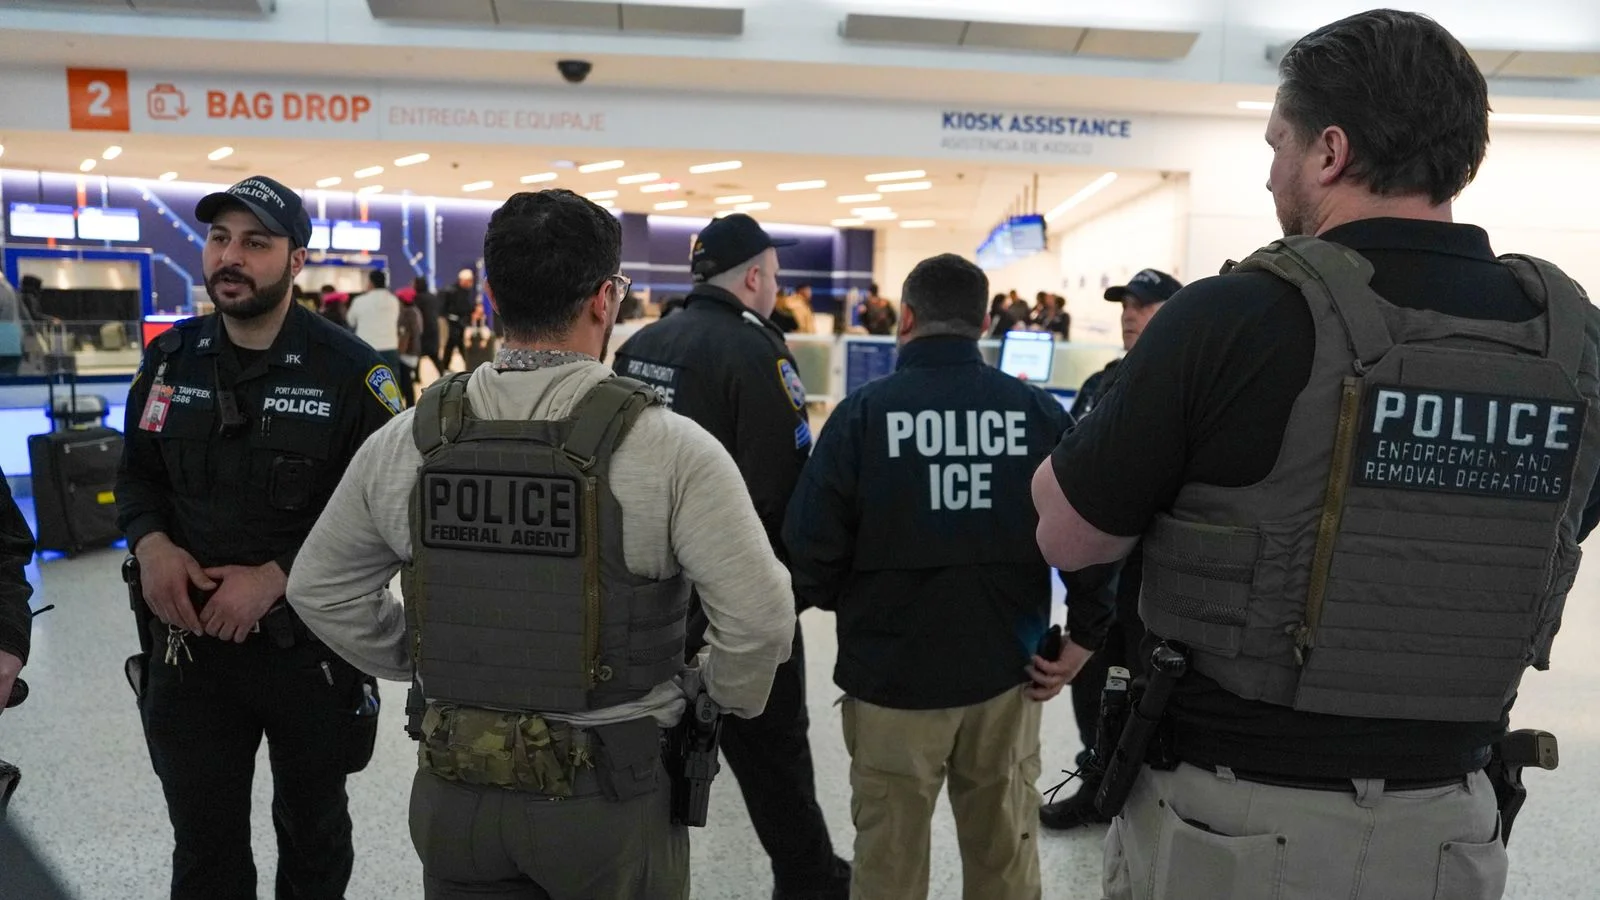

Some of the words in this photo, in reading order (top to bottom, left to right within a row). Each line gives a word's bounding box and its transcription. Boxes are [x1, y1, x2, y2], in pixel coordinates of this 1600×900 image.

[87, 80, 113, 117] 2
[206, 90, 274, 120] BAG
[282, 91, 372, 122] DROP
[388, 106, 480, 127] ENTREGA
[483, 109, 511, 129] DE
[514, 110, 606, 131] EQUIPAJE
[942, 112, 1003, 132] KIOSK
[1008, 115, 1132, 138] ASSISTANCE
[940, 135, 1020, 152] ASISTENCIA
[1022, 138, 1038, 154] DE
[231, 187, 270, 202] POLICE
[241, 179, 286, 209] AUTHORITY
[197, 337, 211, 348] JFK
[285, 354, 301, 364] JFK
[627, 360, 643, 375] PORT
[641, 363, 675, 382] AUTHORITY
[171, 394, 191, 404] 2586
[178, 386, 211, 399] TAWFEEK
[275, 386, 290, 395] PORT
[290, 387, 324, 397] AUTHORITY
[263, 397, 331, 417] POLICE
[1372, 390, 1575, 450] POLICE
[886, 409, 1028, 458] POLICE
[1515, 451, 1551, 472] AND
[929, 463, 993, 510] ICE
[1365, 461, 1446, 486] REMOVAL
[1455, 469, 1562, 494] OPERATIONS
[429, 477, 571, 528] POLICE
[431, 524, 502, 544] FEDERAL
[511, 529, 570, 548] AGENT
